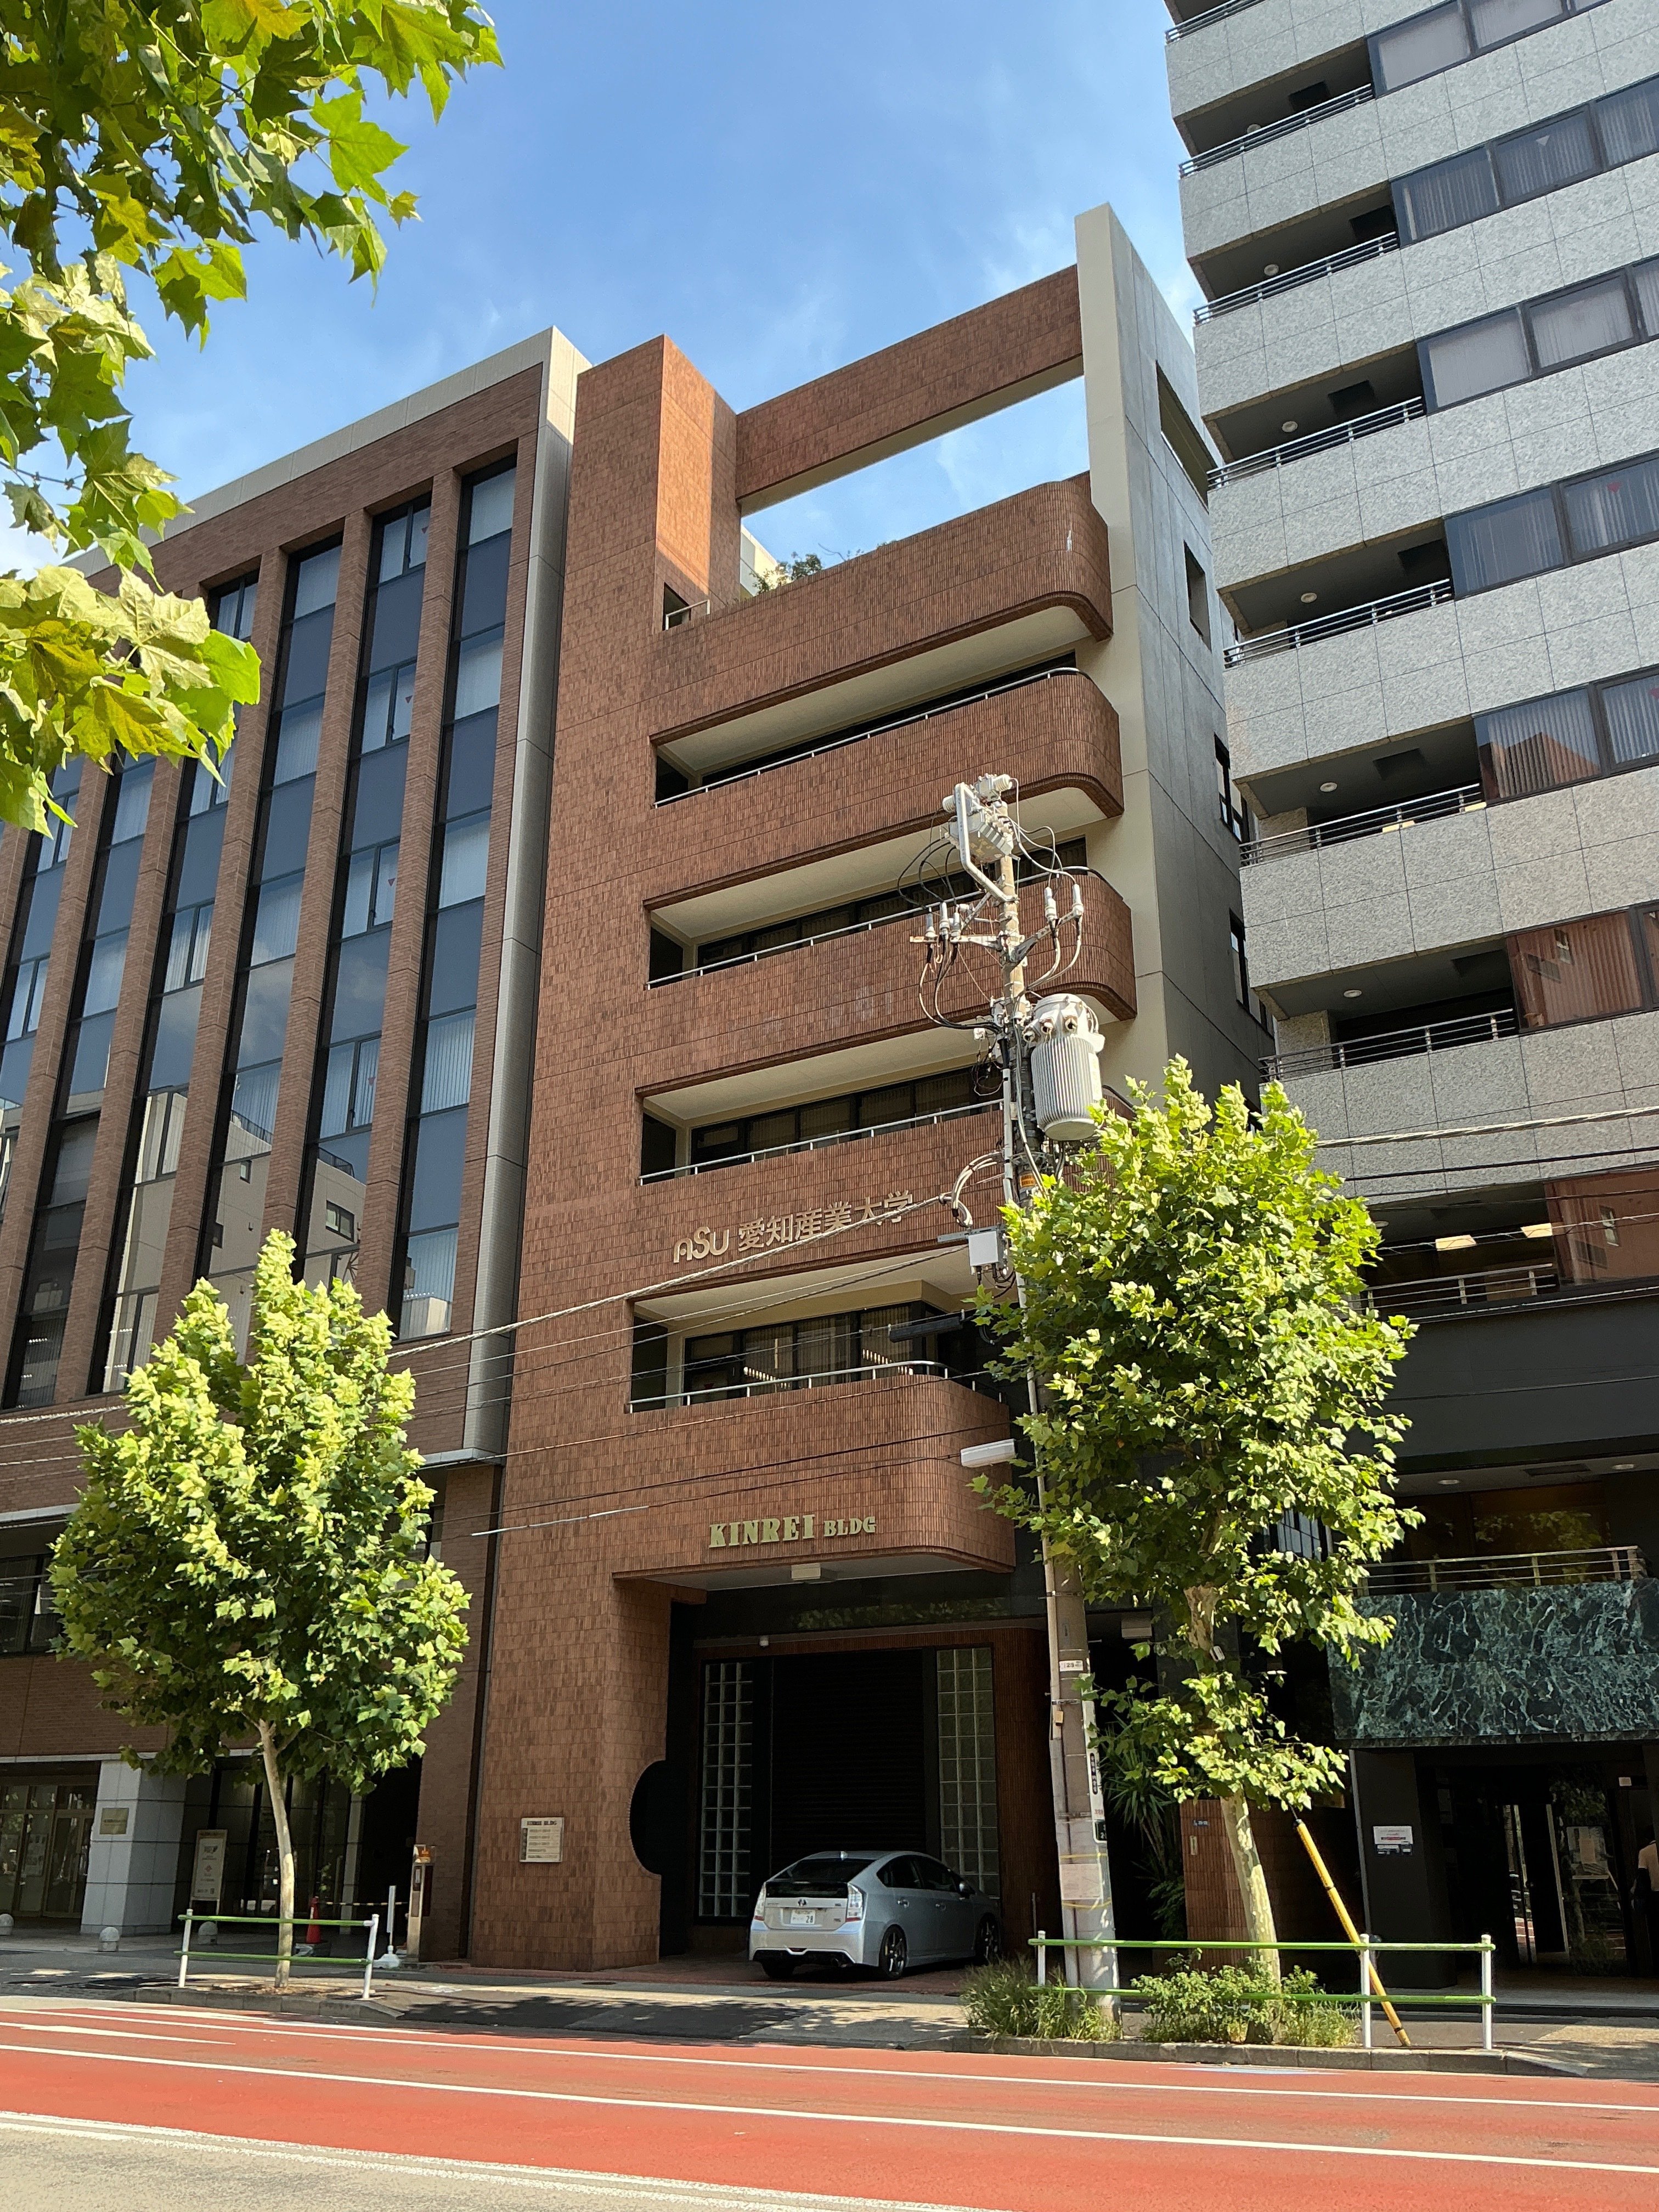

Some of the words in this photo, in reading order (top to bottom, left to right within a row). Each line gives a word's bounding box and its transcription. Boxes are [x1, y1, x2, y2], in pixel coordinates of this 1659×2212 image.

[673, 1226, 730, 1263] ASU
[738, 1189, 913, 1252] 愛知産業大学
[708, 1514, 816, 1548] KINREI
[823, 1516, 877, 1537] BLDG
